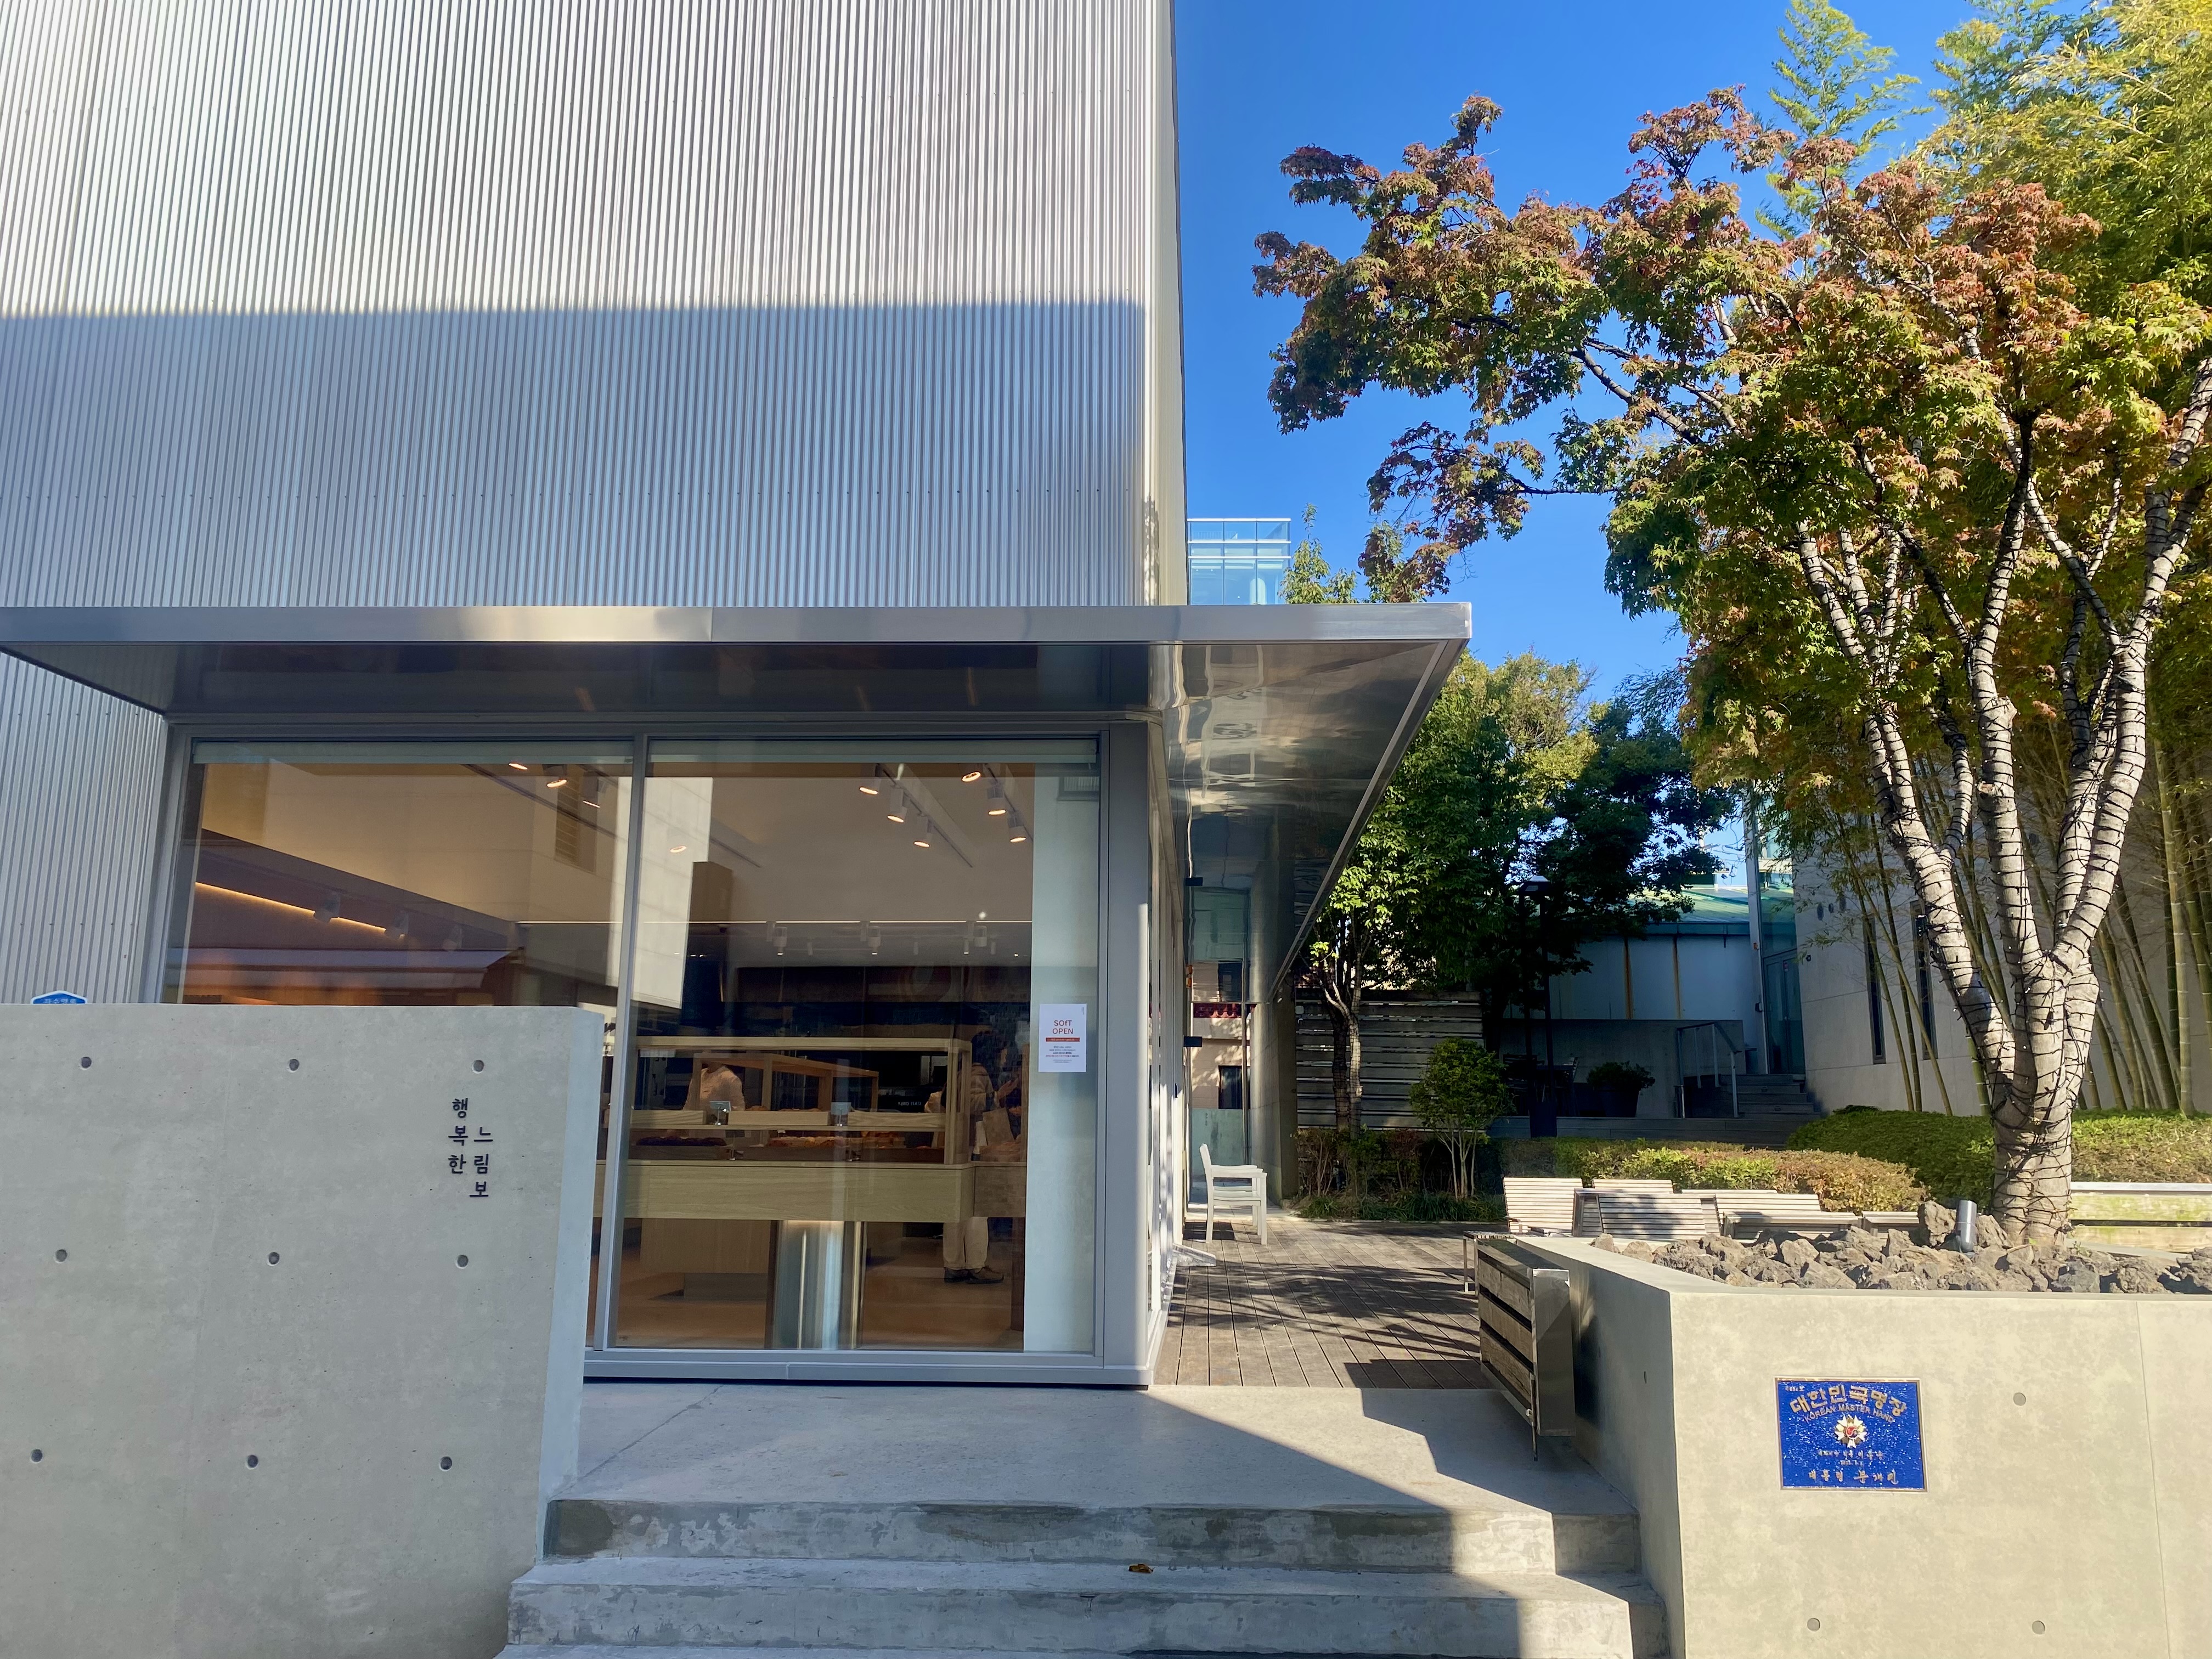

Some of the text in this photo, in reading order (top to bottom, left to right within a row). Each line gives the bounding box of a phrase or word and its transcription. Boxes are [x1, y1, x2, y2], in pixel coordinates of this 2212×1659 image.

[448, 1098, 469, 1174] 행복한
[469, 1126, 493, 1198] 느림보
[1789, 1384, 1907, 1417] 대한민국명장
[1804, 1403, 1895, 1424] KOREAN MASTER HAND
